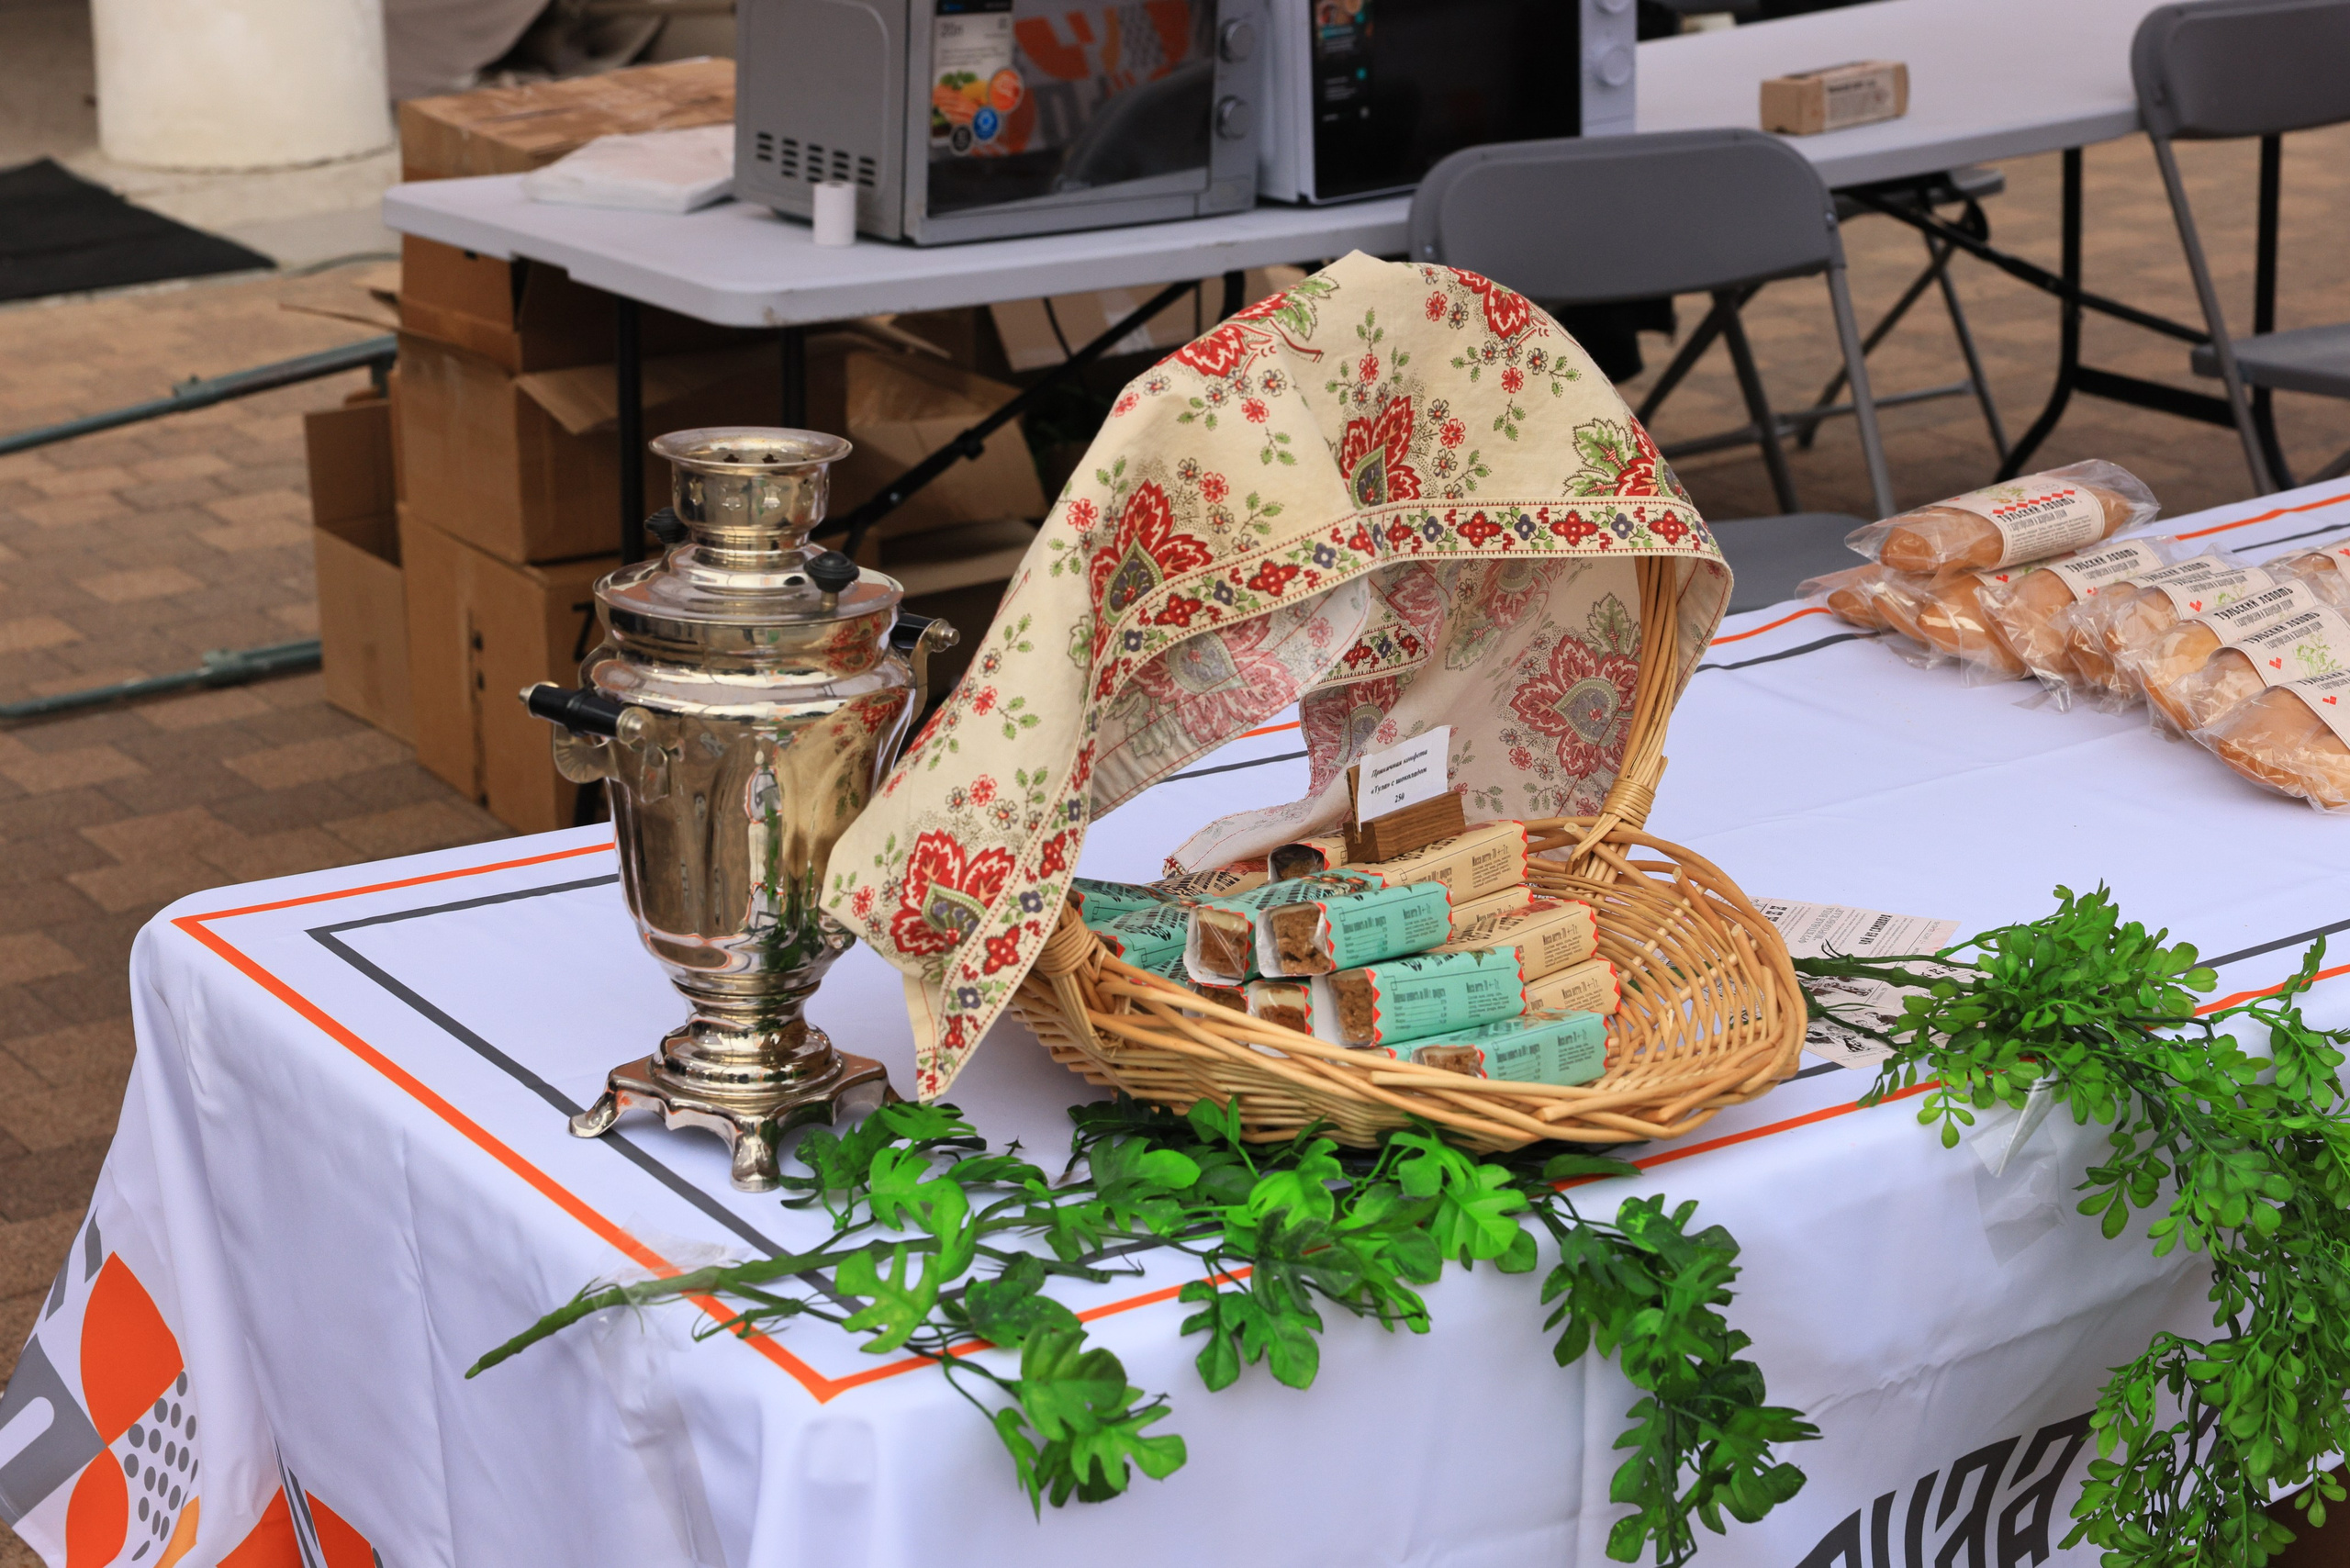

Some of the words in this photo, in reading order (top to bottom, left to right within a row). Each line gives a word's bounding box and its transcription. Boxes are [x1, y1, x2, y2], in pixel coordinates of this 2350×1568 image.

[1997, 505, 2041, 523] Тульский
[2042, 496, 2076, 511] лапоть
[2065, 555, 2107, 573] Тульский
[2107, 548, 2139, 564] лапоть
[2213, 599, 2260, 621] Тульский
[2258, 586, 2294, 605] лапоть
[2243, 624, 2288, 644] Тульский
[2285, 611, 2321, 628] лапоть
[1371, 760, 1402, 778] Пряничная
[1403, 749, 1428, 763] конфета
[1371, 782, 1391, 795] «Тула»
[1395, 767, 1427, 785] шоколадом
[1394, 791, 1405, 803] 250
[1869, 913, 1893, 933] САМОВАРА
